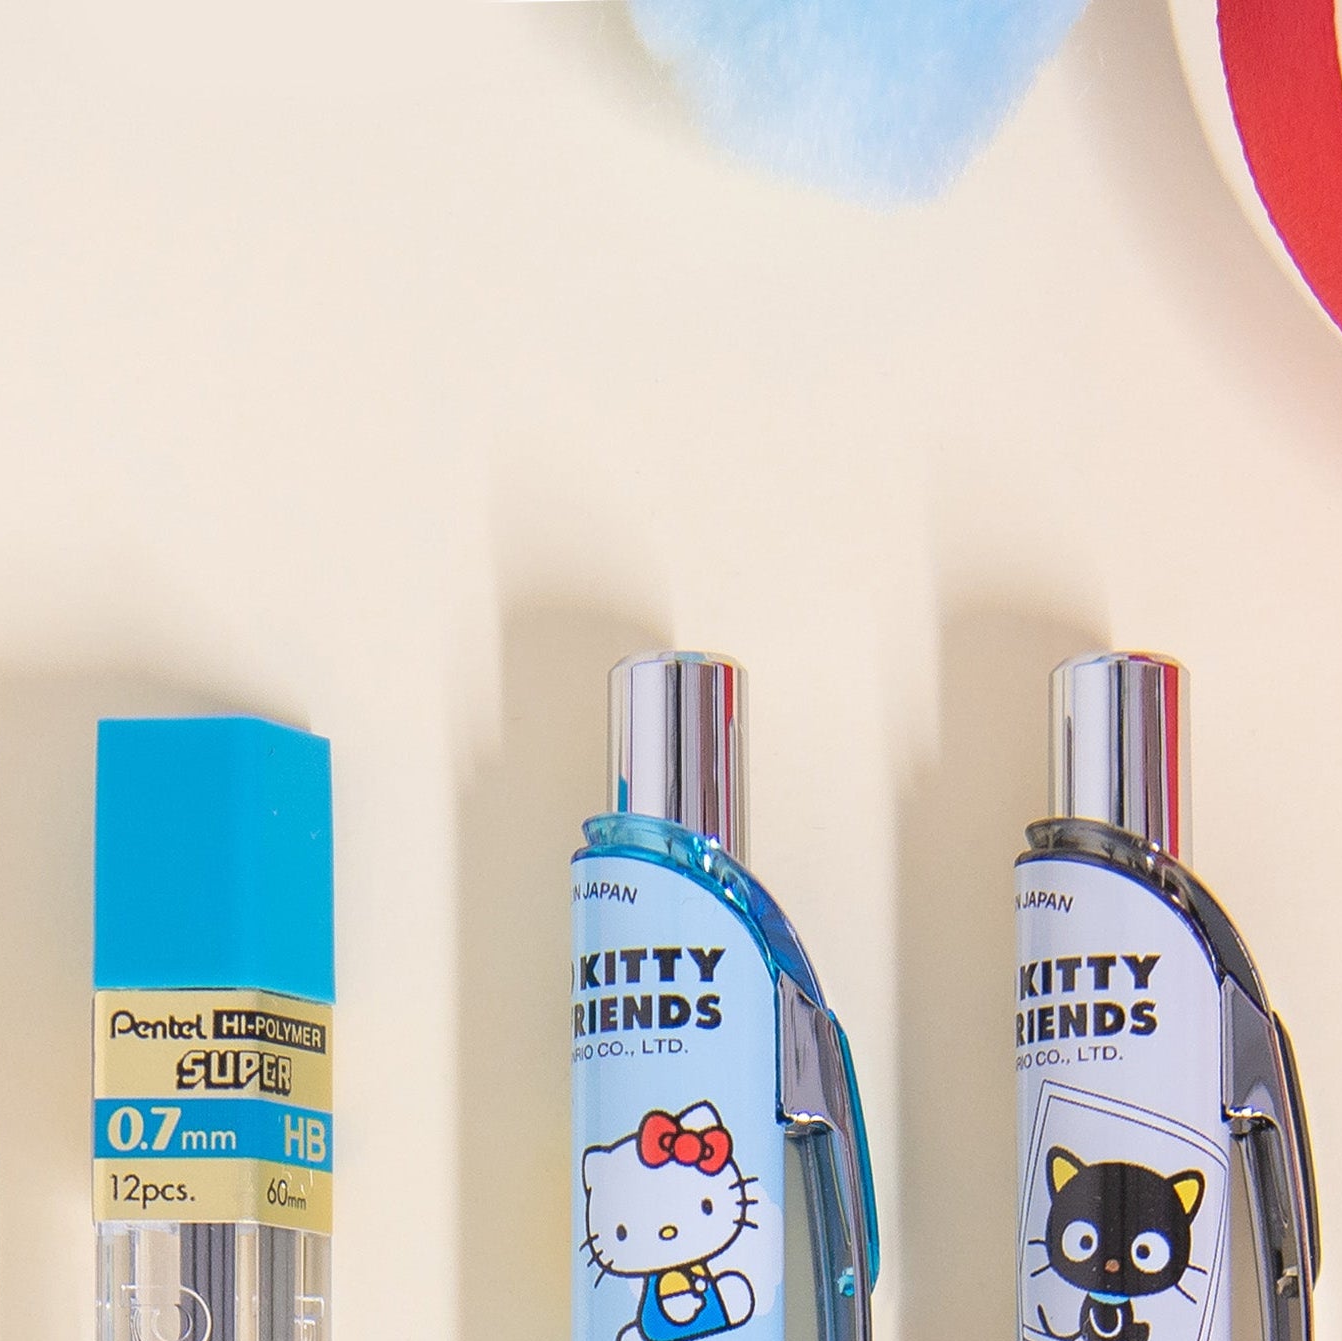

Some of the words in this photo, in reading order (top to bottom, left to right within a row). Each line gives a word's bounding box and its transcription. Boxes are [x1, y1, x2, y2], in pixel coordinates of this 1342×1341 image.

[583, 882, 637, 904] JAPAN
[1022, 891, 1073, 913] JAPAN
[580, 948, 725, 991] KITTY
[1020, 954, 1161, 1000] KITTY
[110, 1010, 207, 1039] Pentel
[221, 1013, 322, 1049] HI-POLYMER
[572, 995, 722, 1039] RIENDS
[1016, 1001, 1157, 1048] RIENDS
[598, 1041, 635, 1057] CO.,
[642, 1038, 688, 1054] LTD.
[1036, 1049, 1070, 1066] CO.,
[1077, 1045, 1123, 1062] LTD.
[176, 1050, 292, 1096] SUPER
[283, 1114, 327, 1162] HB
[111, 1173, 196, 1209] 12pcs.
[267, 1178, 307, 1210] 60mm
